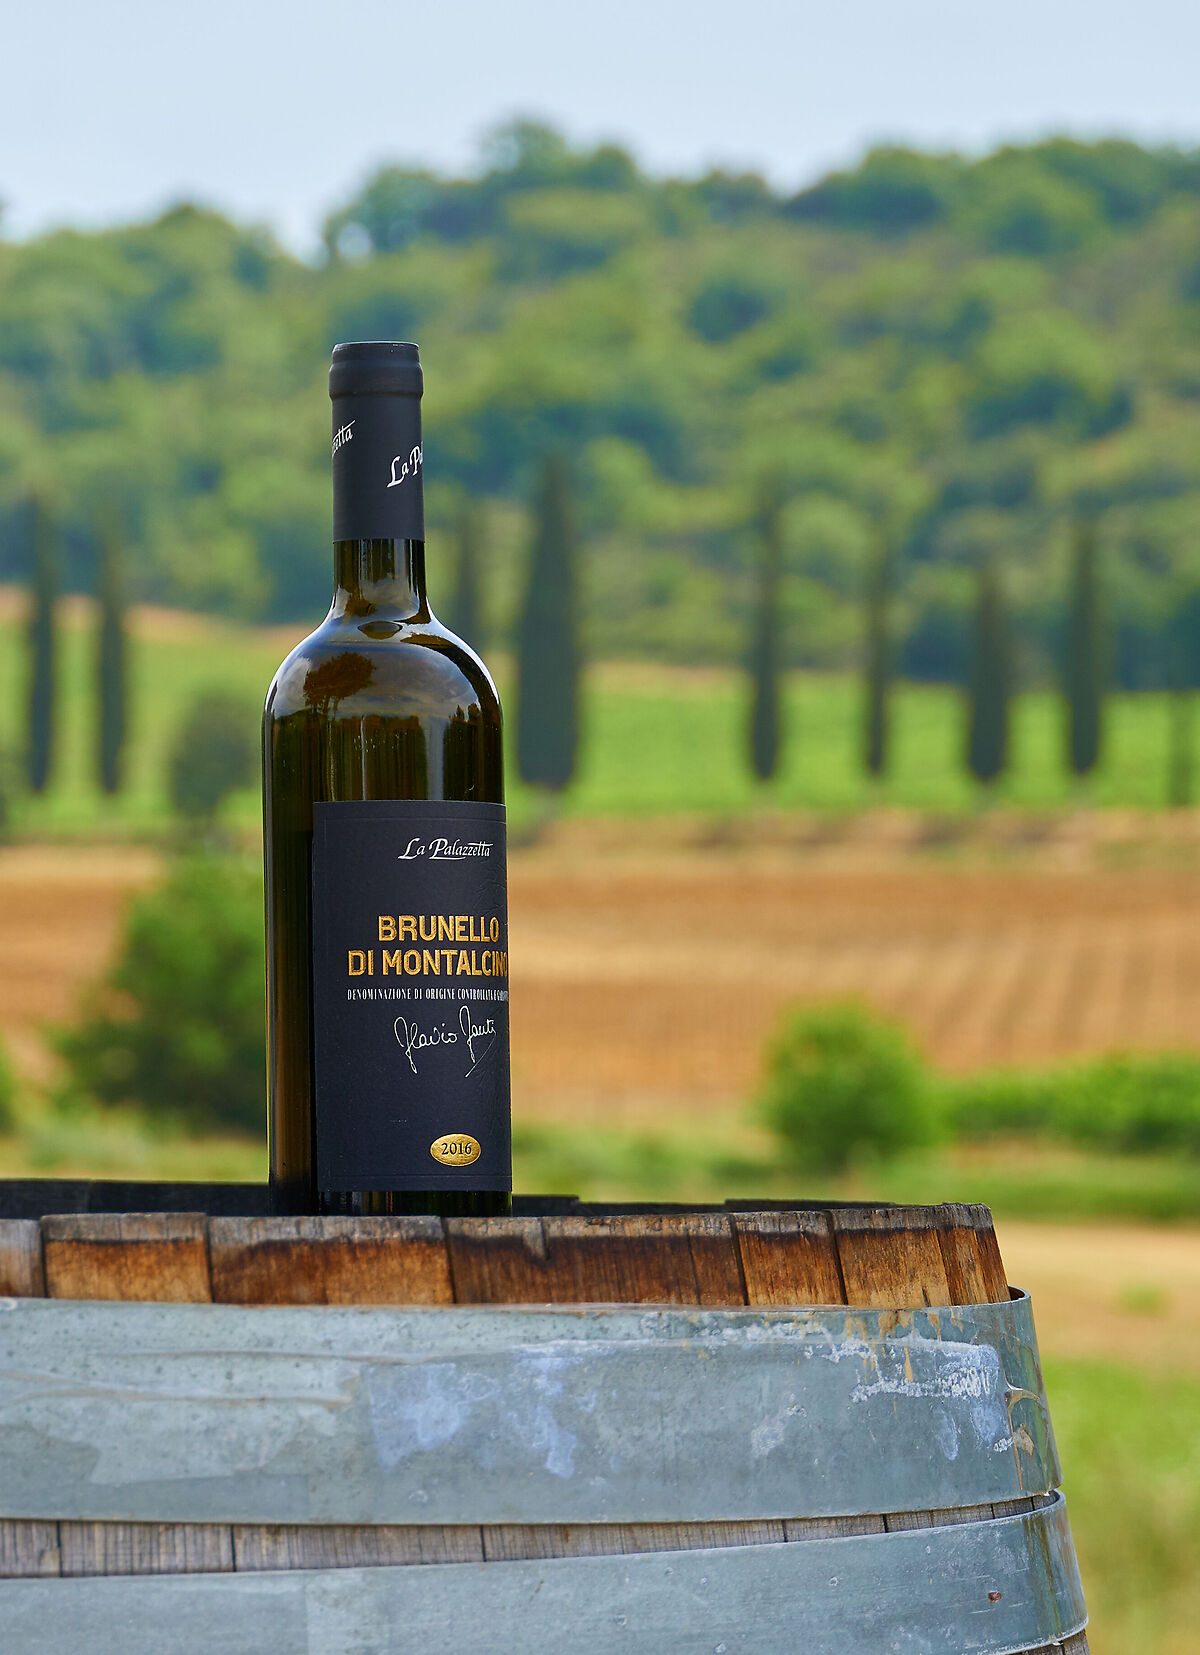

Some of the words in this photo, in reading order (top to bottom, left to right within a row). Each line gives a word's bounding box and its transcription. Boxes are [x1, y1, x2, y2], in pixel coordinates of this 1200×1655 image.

[397, 837, 426, 860] La
[428, 838, 494, 861] Palazzetta
[378, 915, 500, 943] BRUNELLO
[348, 950, 374, 976] DI
[382, 950, 508, 977] MONTALCINO
[347, 988, 412, 1001] DENOMINAZIONE
[414, 988, 423, 1001] DI
[425, 988, 456, 1001] ORIGINE
[441, 1142, 472, 1156] 2016
